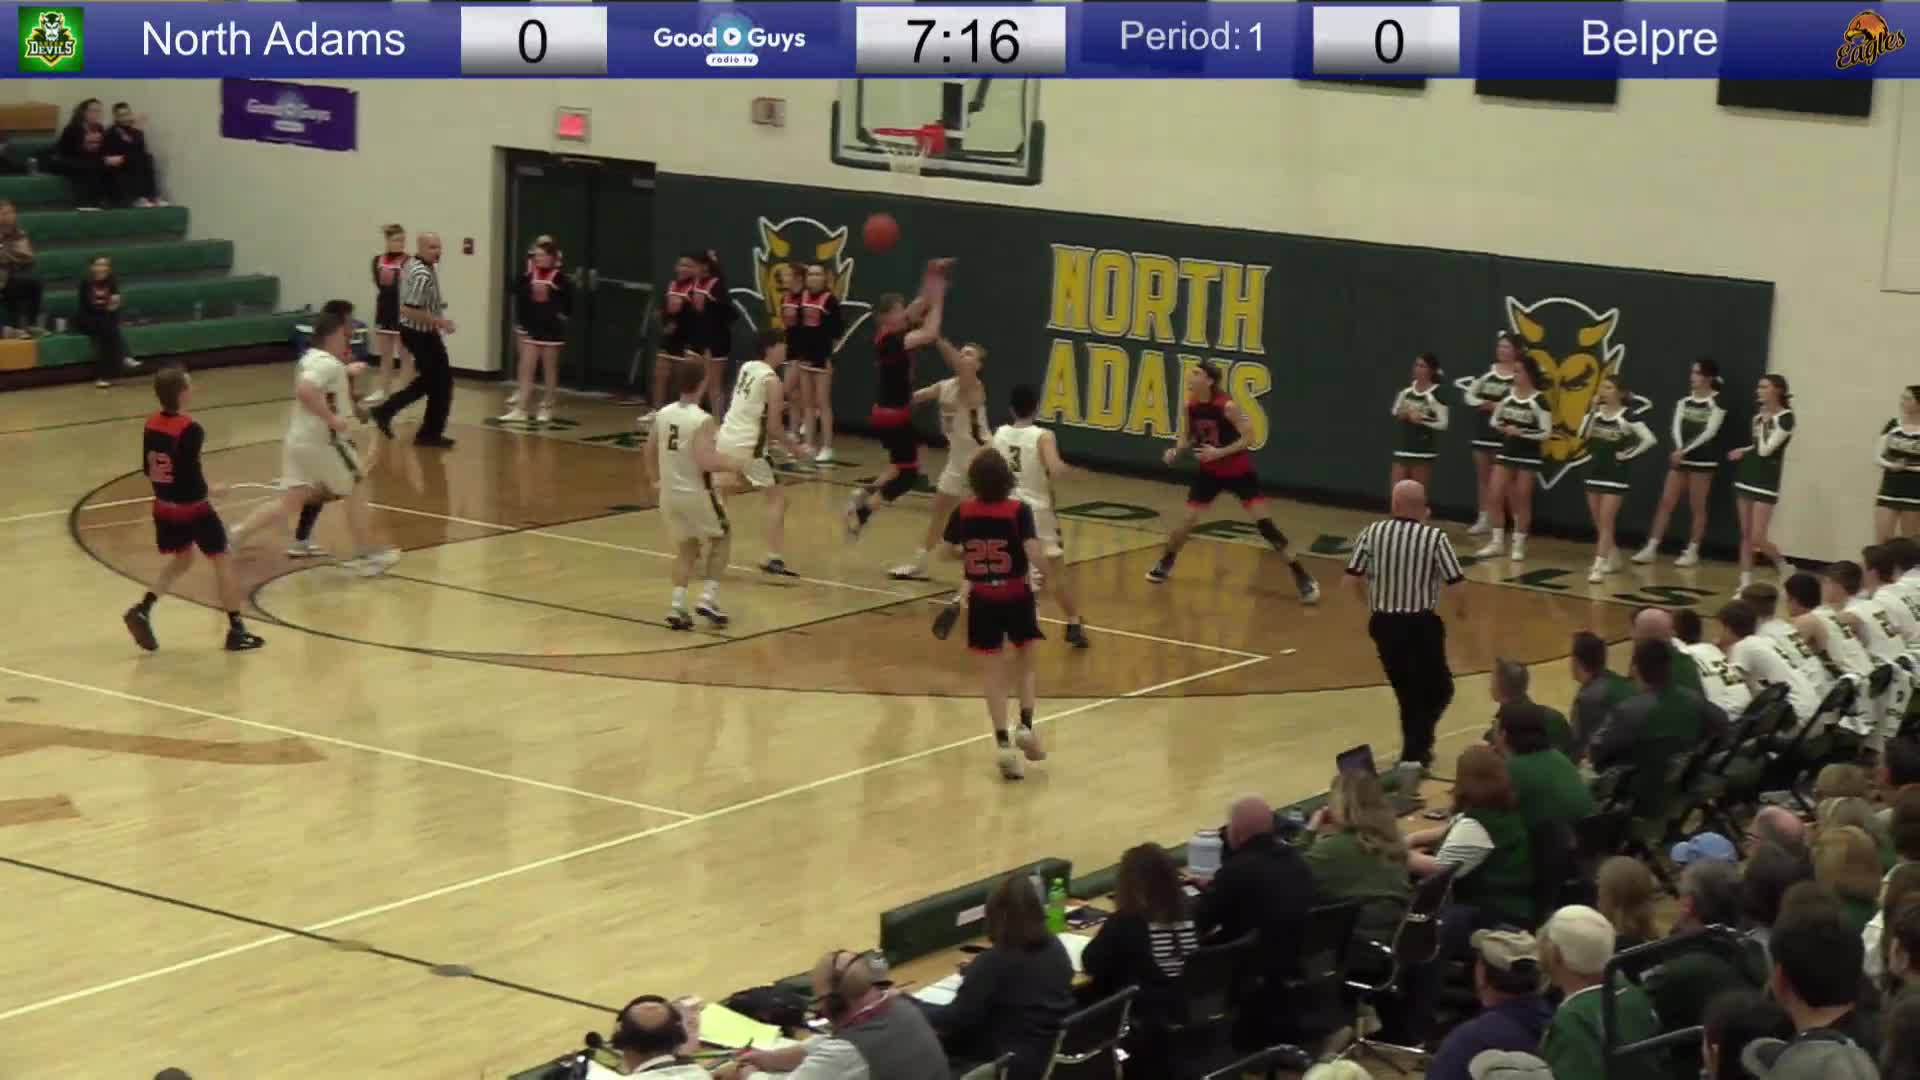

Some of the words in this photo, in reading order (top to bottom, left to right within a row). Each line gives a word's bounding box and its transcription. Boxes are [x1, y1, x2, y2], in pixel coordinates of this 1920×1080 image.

[1046, 243, 1272, 354] NORTH
[667, 424, 679, 451] 2
[1008, 445, 1022, 472] 3
[964, 539, 1012, 575] 25
